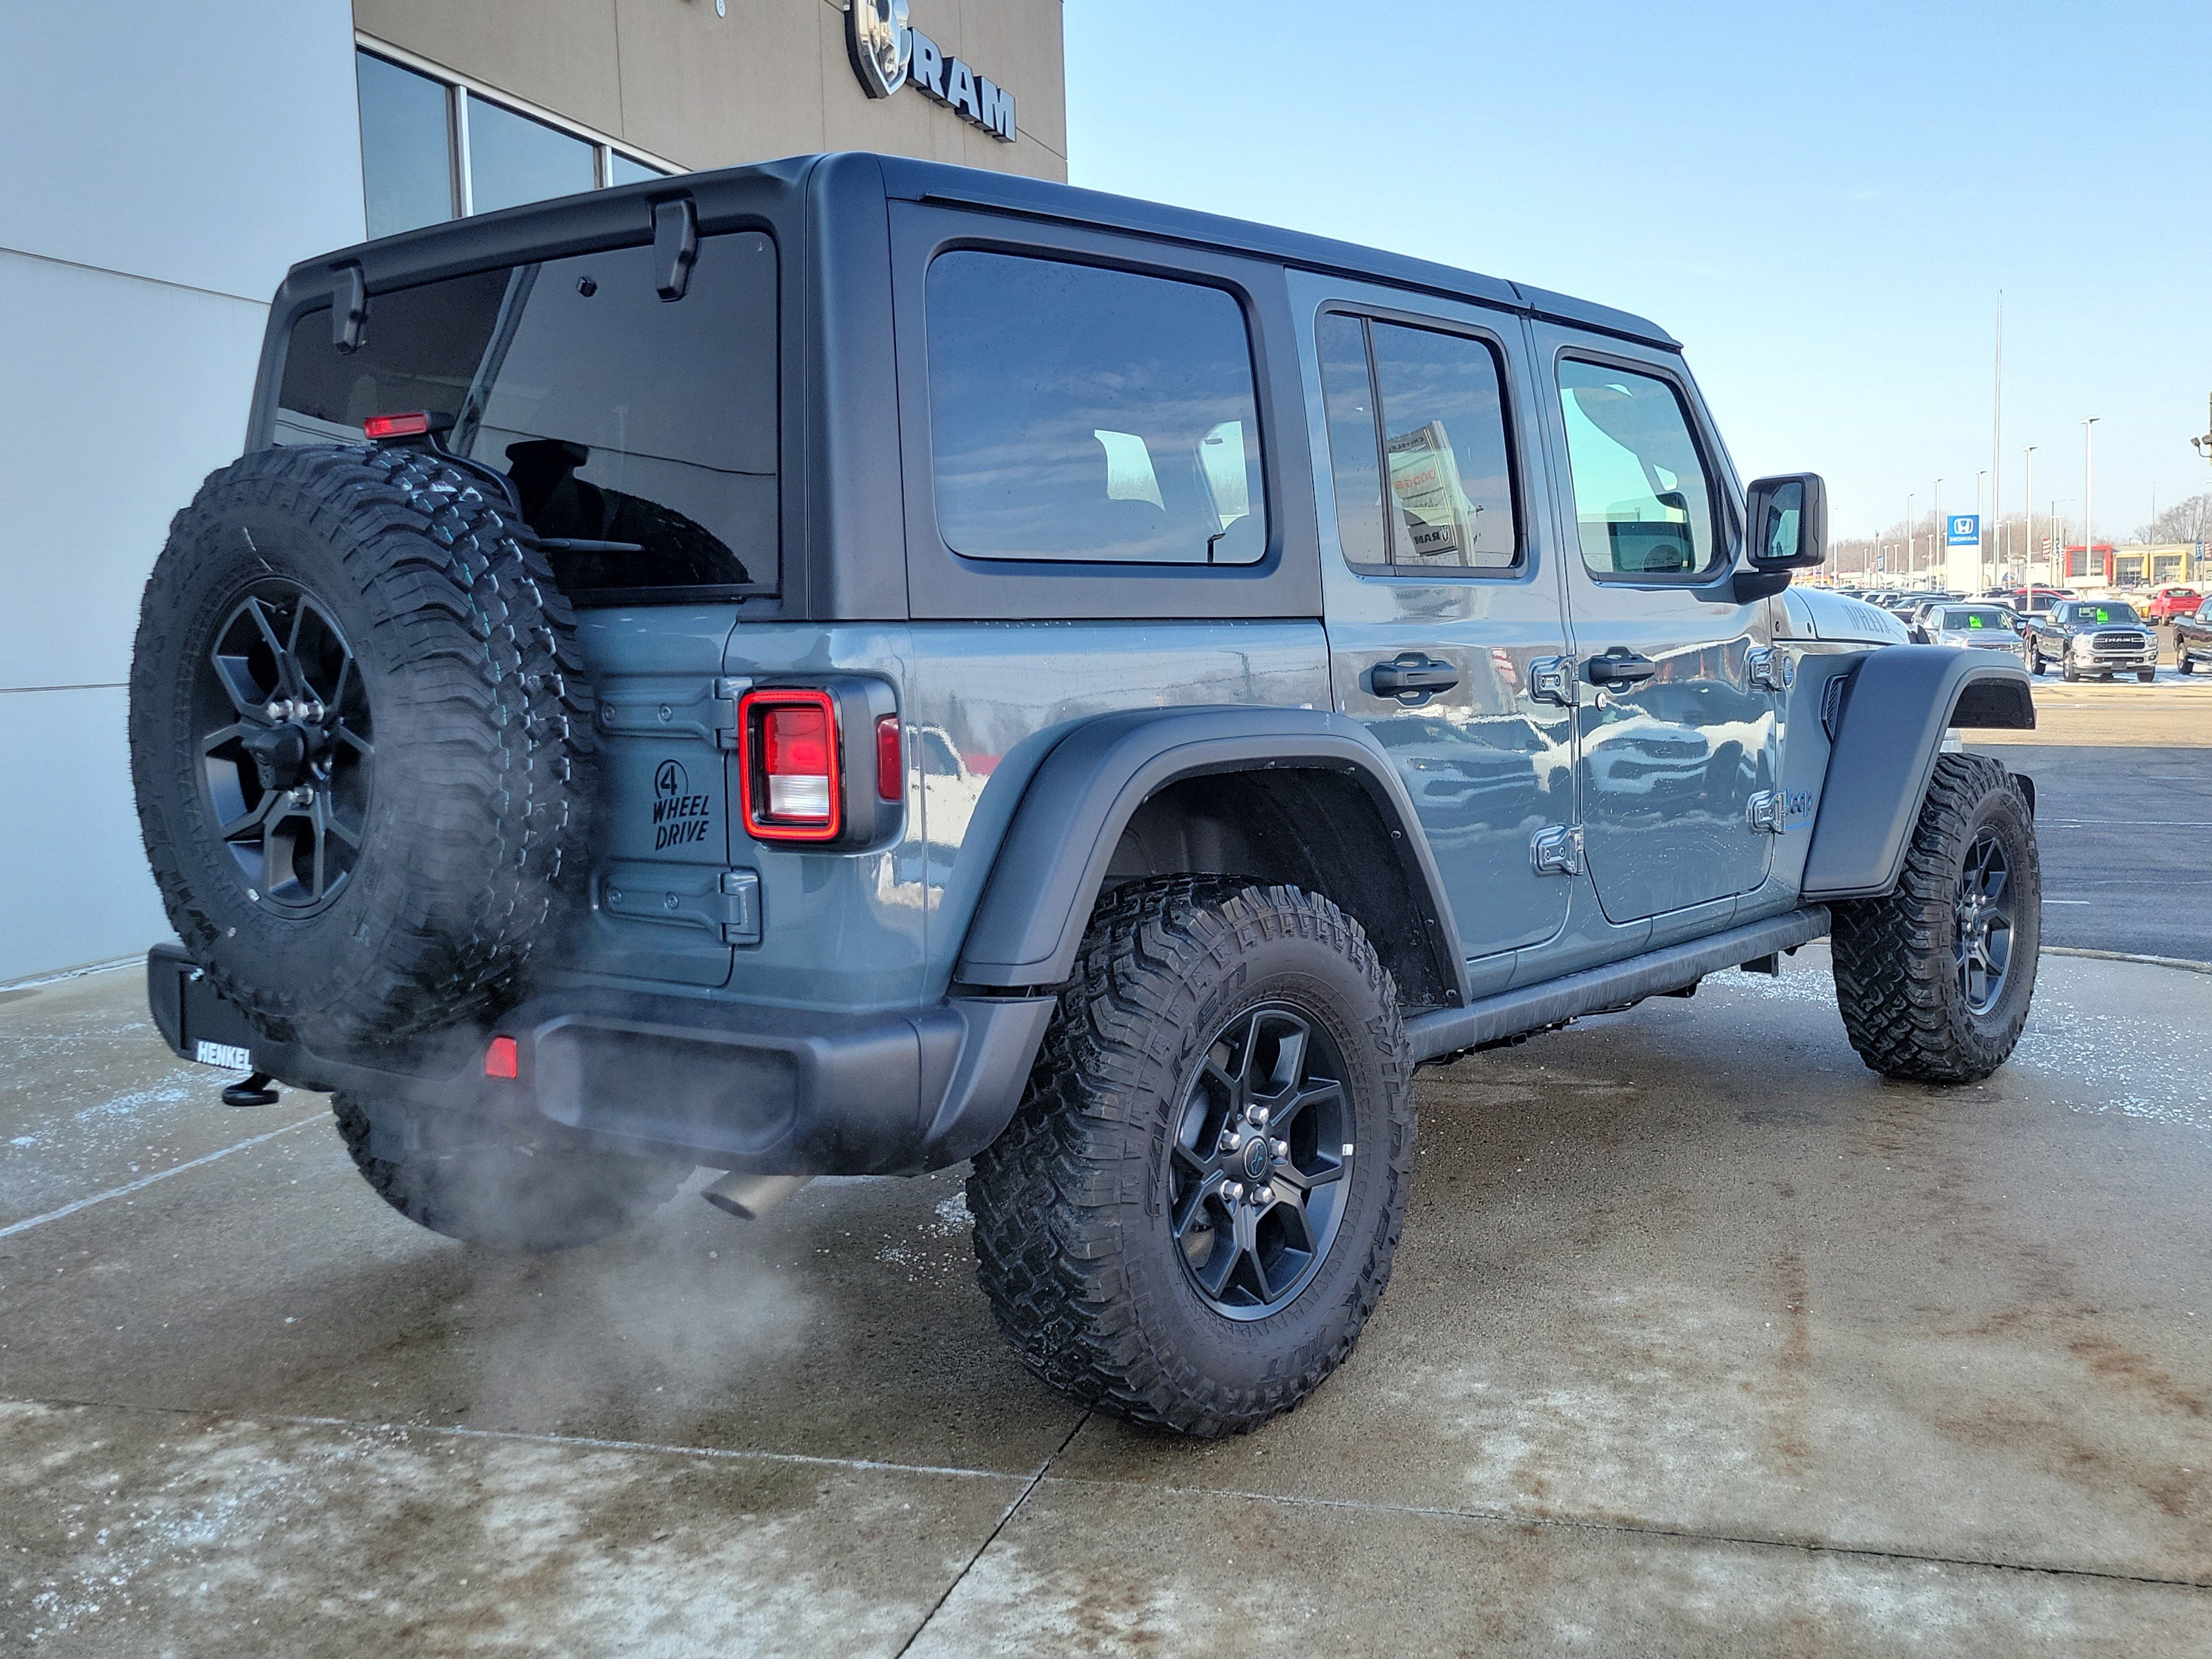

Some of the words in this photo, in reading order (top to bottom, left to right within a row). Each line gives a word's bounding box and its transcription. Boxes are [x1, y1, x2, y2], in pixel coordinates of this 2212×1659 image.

[911, 27, 1016, 143] RAM
[653, 795, 709, 824] WHEEL
[656, 820, 709, 850] DRIVE
[198, 1041, 252, 1071] HENKEL
